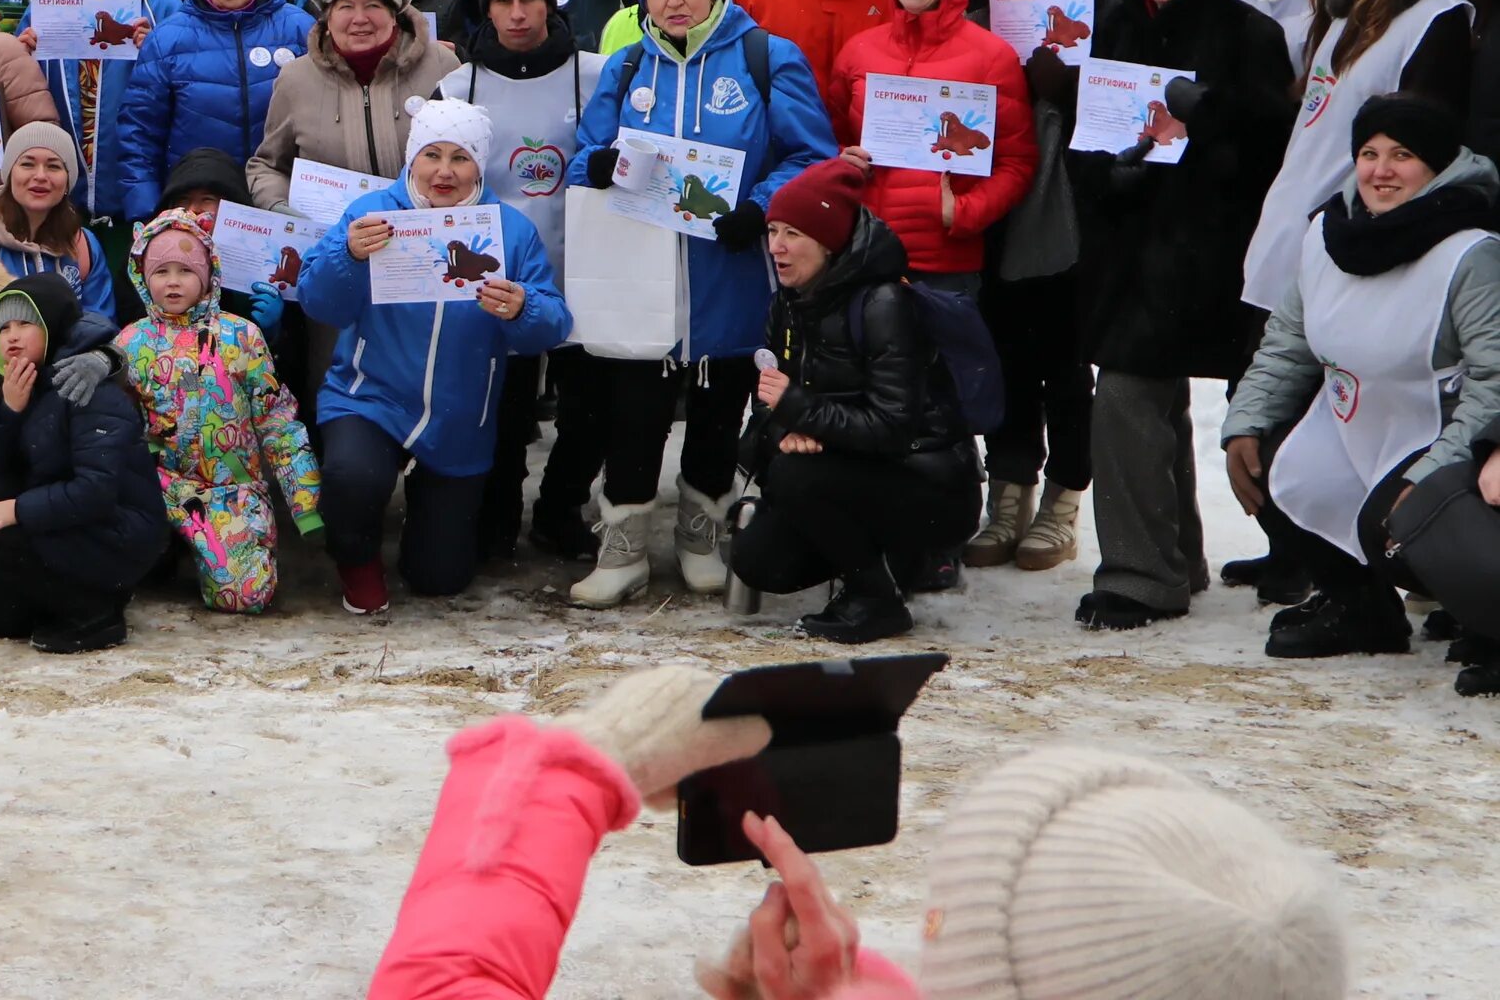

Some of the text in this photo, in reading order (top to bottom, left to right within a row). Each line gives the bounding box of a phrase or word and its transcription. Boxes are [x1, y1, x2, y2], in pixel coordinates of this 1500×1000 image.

[1088, 75, 1138, 91] СЕРТИФИКАТ
[874, 89, 928, 104] СЕРТИФИКАТ
[299, 173, 348, 191] СЕРТИФИКАТ
[223, 218, 273, 237] СЕРТИФИКАТ
[394, 227, 433, 238] ТИФИКАТ
